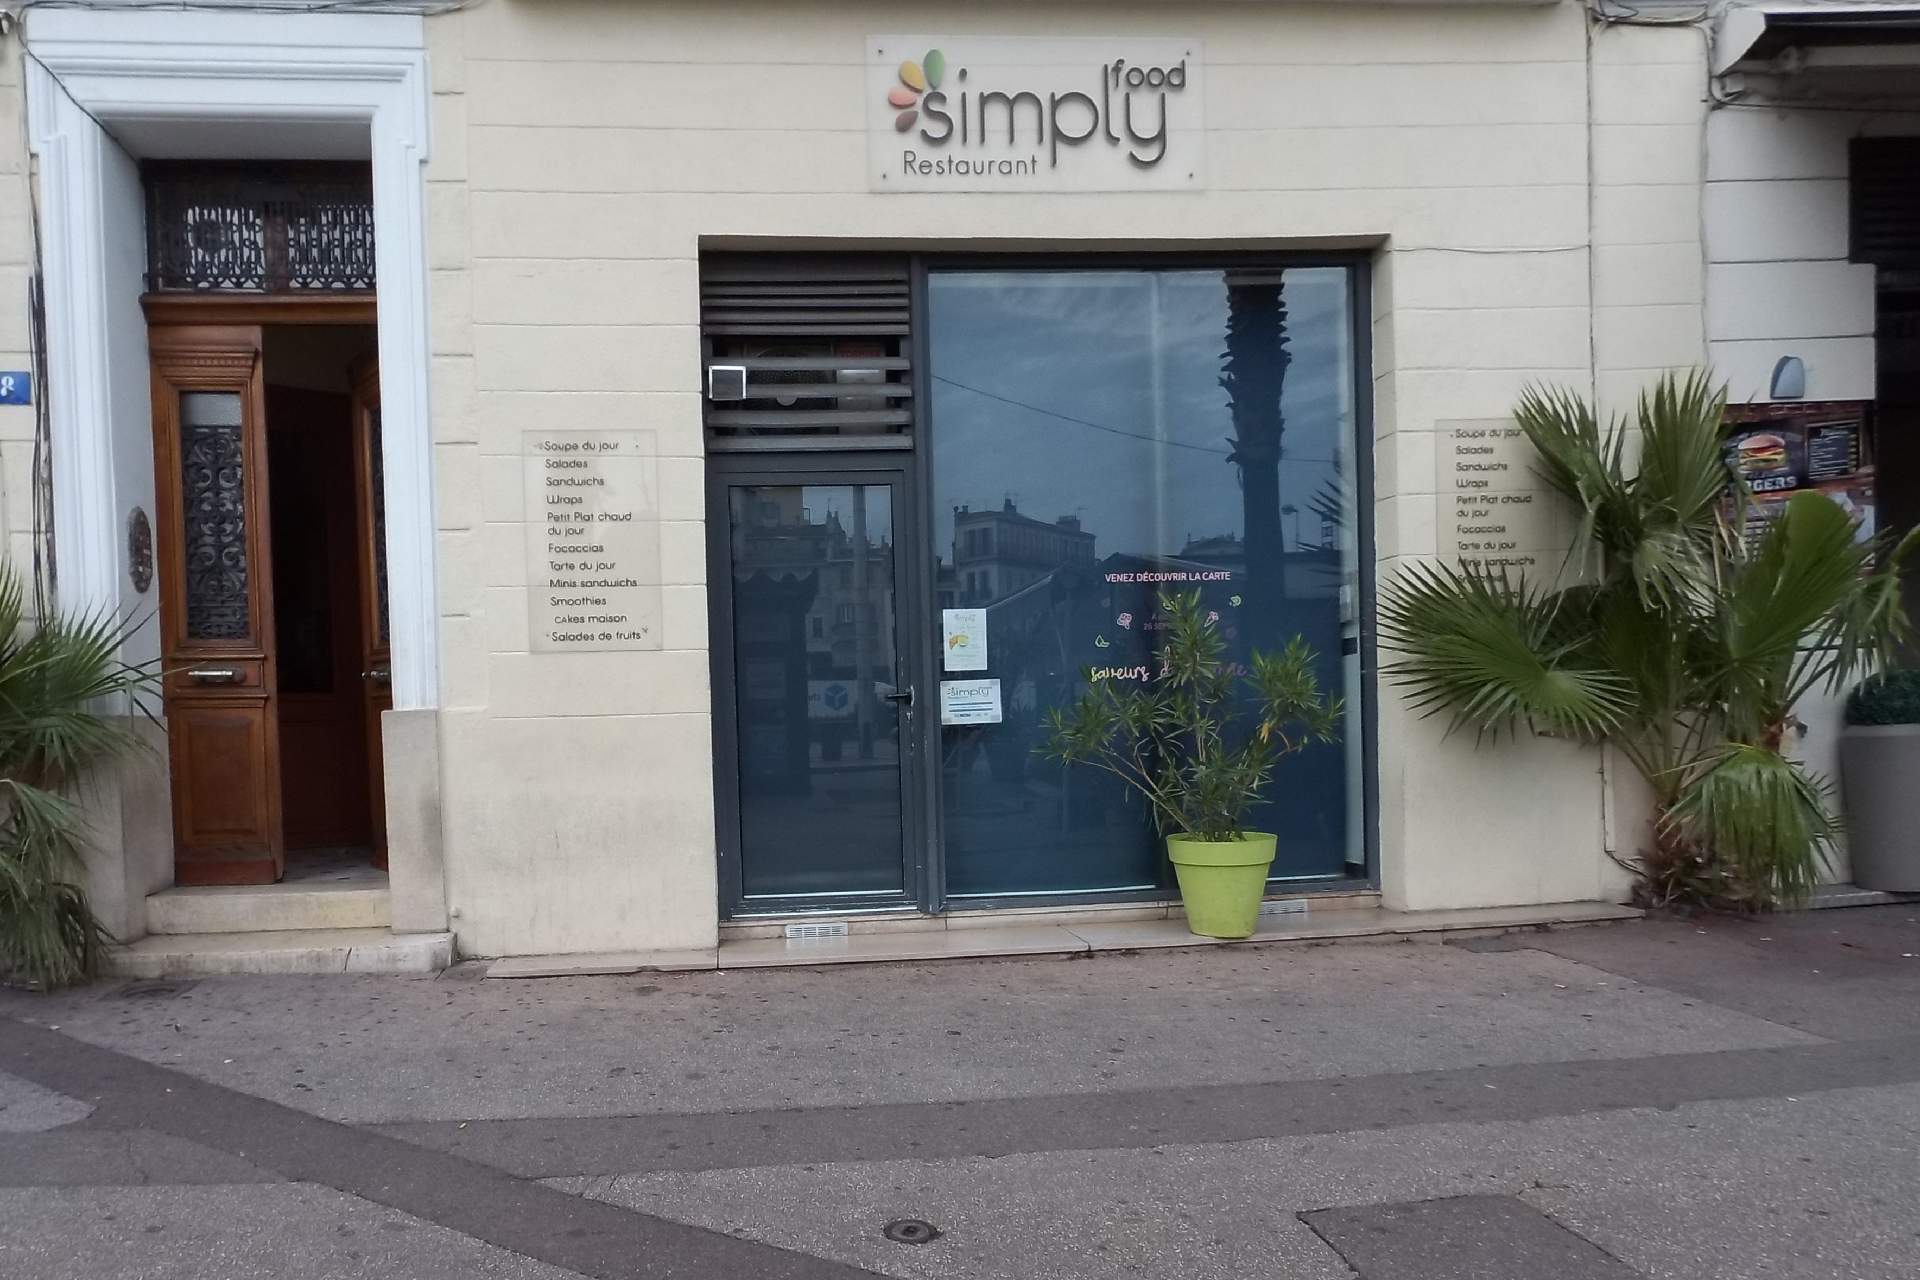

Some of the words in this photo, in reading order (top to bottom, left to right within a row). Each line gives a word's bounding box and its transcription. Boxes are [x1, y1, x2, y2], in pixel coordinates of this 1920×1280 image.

[1111, 58, 1186, 88] food
[920, 64, 1167, 171] simply
[903, 150, 1038, 175] Restaurant
[1455, 428, 1486, 439] Soupe
[1489, 428, 1500, 437] du
[1503, 428, 1521, 439] jour
[543, 440, 579, 452] Soupe
[582, 440, 596, 450] du
[598, 440, 619, 452] jour
[1456, 445, 1494, 455] Salades
[545, 458, 588, 469] Salades
[1456, 461, 1508, 472] Sandwichs
[546, 476, 605, 487] Sandwichs
[1456, 479, 1489, 489] Wraps
[546, 495, 583, 506] Wraps
[1456, 495, 1478, 504] Petit
[1480, 495, 1498, 504] Plat
[1501, 494, 1532, 503] chaud
[547, 512, 570, 522] Petit
[574, 511, 594, 522] Plat
[598, 511, 632, 521] chaud
[1456, 509, 1468, 517] du
[1471, 509, 1489, 519] jour
[547, 526, 561, 536] du
[564, 526, 584, 537] jour
[1457, 525, 1506, 534] Focaccias
[548, 543, 604, 553] Focaccias
[1457, 541, 1480, 550] Tarte
[1483, 541, 1496, 550] du
[1498, 541, 1516, 551] jour
[549, 560, 575, 571] Tarte
[579, 560, 593, 570] du
[595, 560, 616, 572] jour
[1105, 573, 1134, 583] VENEZ
[1136, 571, 1187, 582] DÉCOUVRIR
[1189, 572, 1201, 581] LA
[1202, 571, 1231, 581] CARTE
[549, 578, 577, 588] Minis
[580, 578, 638, 588] sandwichs
[550, 596, 607, 607] Smoothies
[588, 613, 627, 623] maison
[551, 631, 594, 642] Salades
[598, 631, 612, 641] de
[616, 631, 641, 640] fruits
